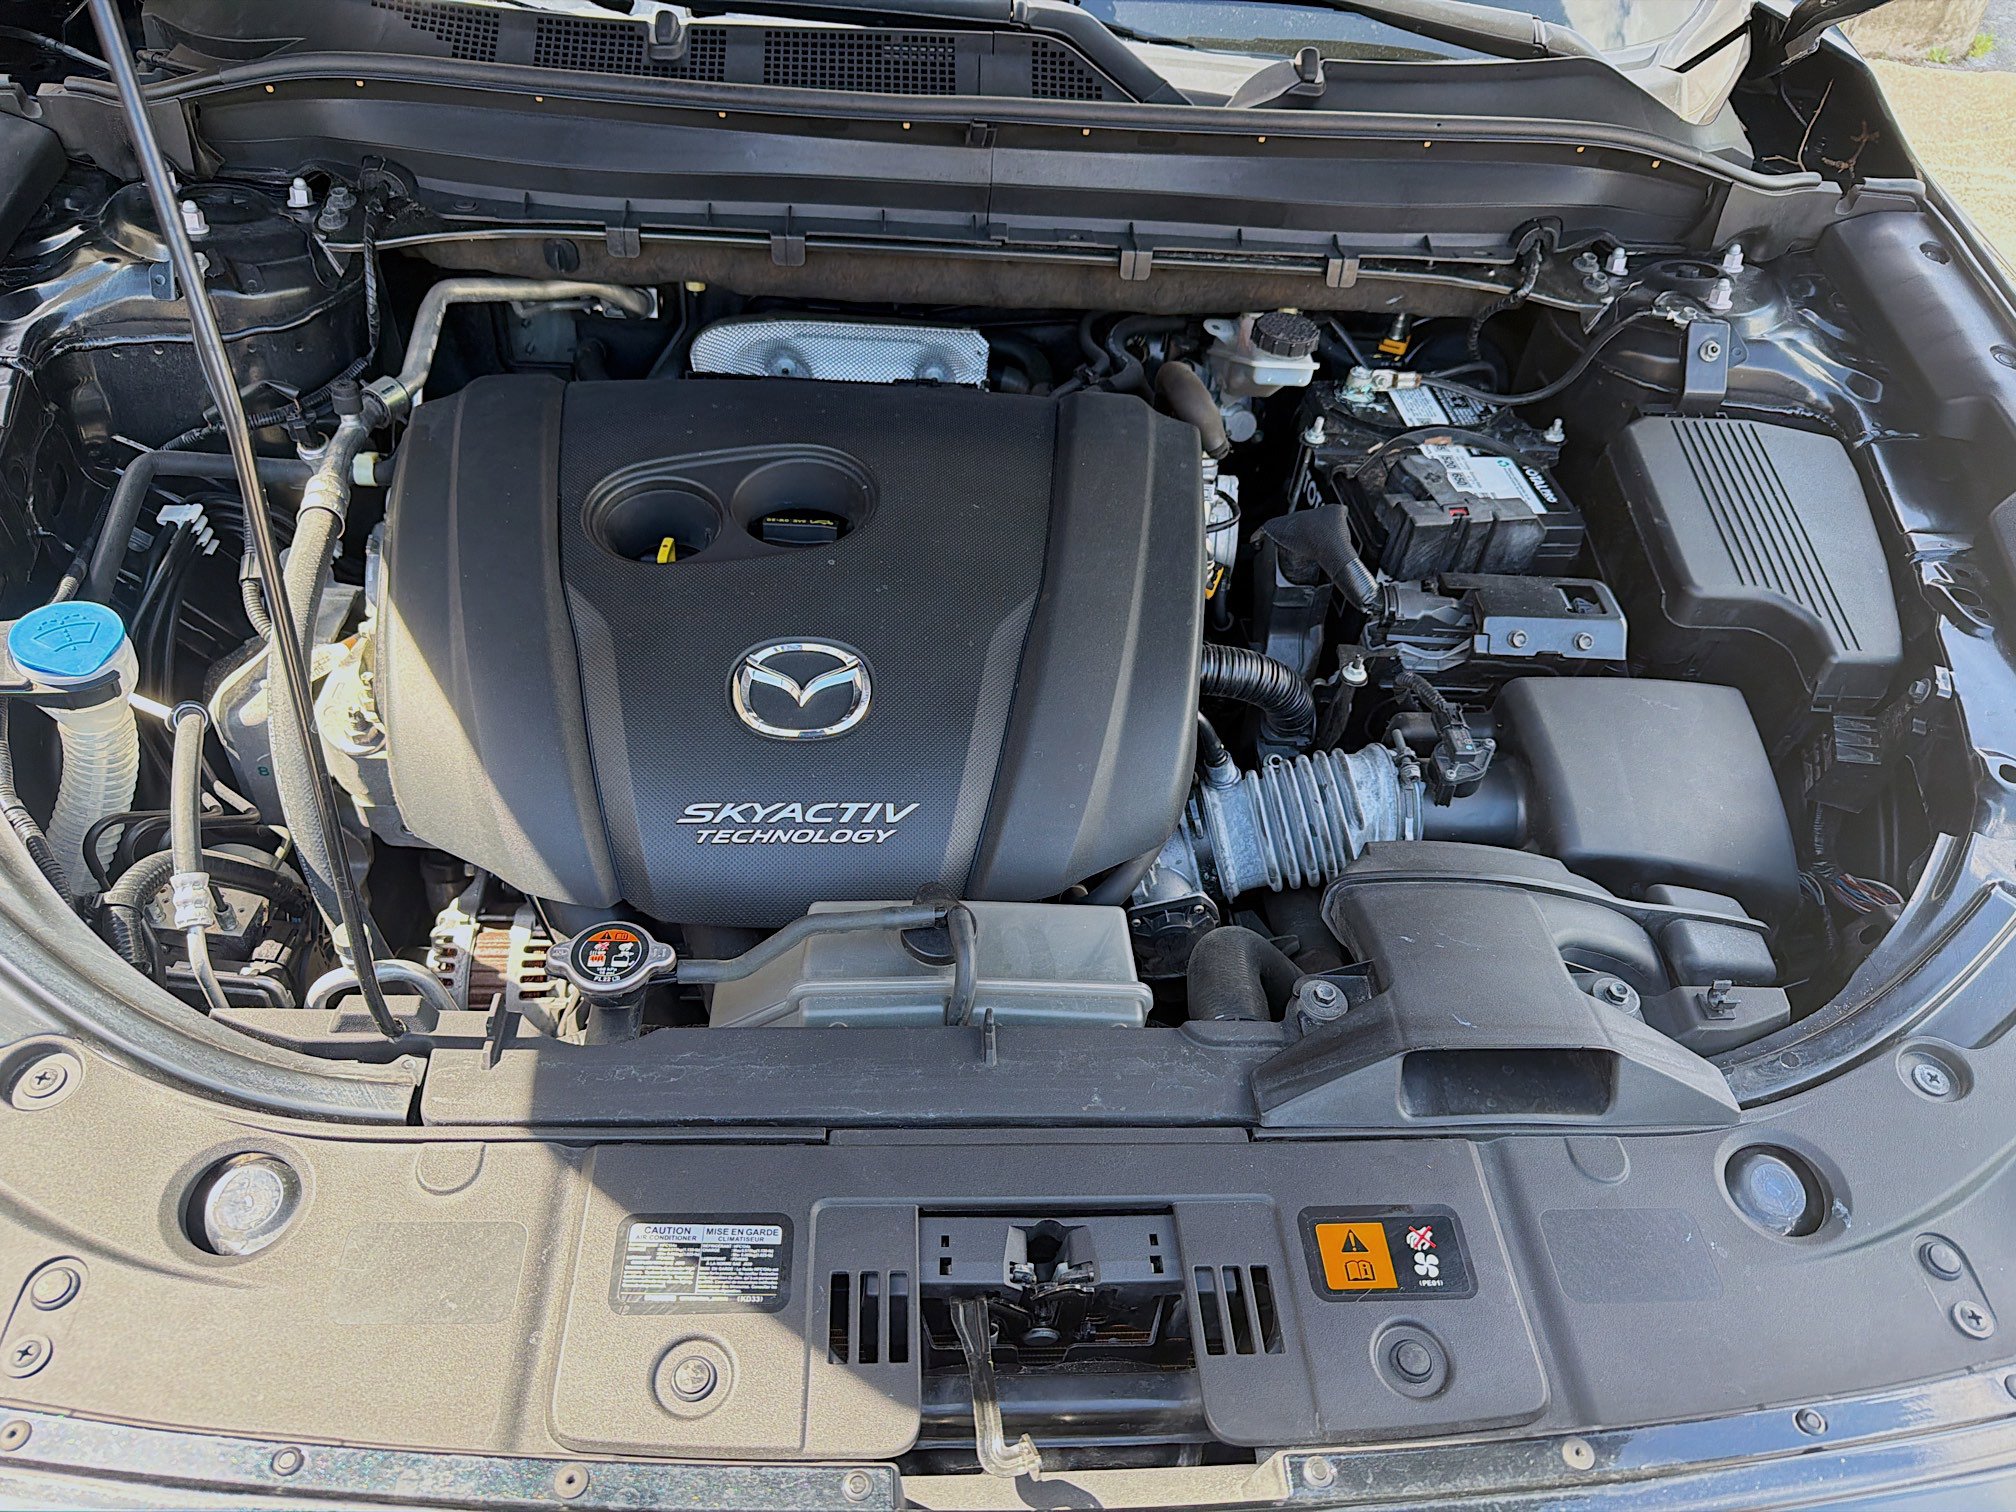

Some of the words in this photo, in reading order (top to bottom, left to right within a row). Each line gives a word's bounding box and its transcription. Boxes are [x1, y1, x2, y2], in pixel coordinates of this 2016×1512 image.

[676, 802, 920, 824] SKYACTIV
[696, 829, 897, 844] TECHNOLOGY
[644, 1226, 692, 1235] CAUTION
[706, 1228, 728, 1236] MISE
[745, 1229, 779, 1237] GARDE
